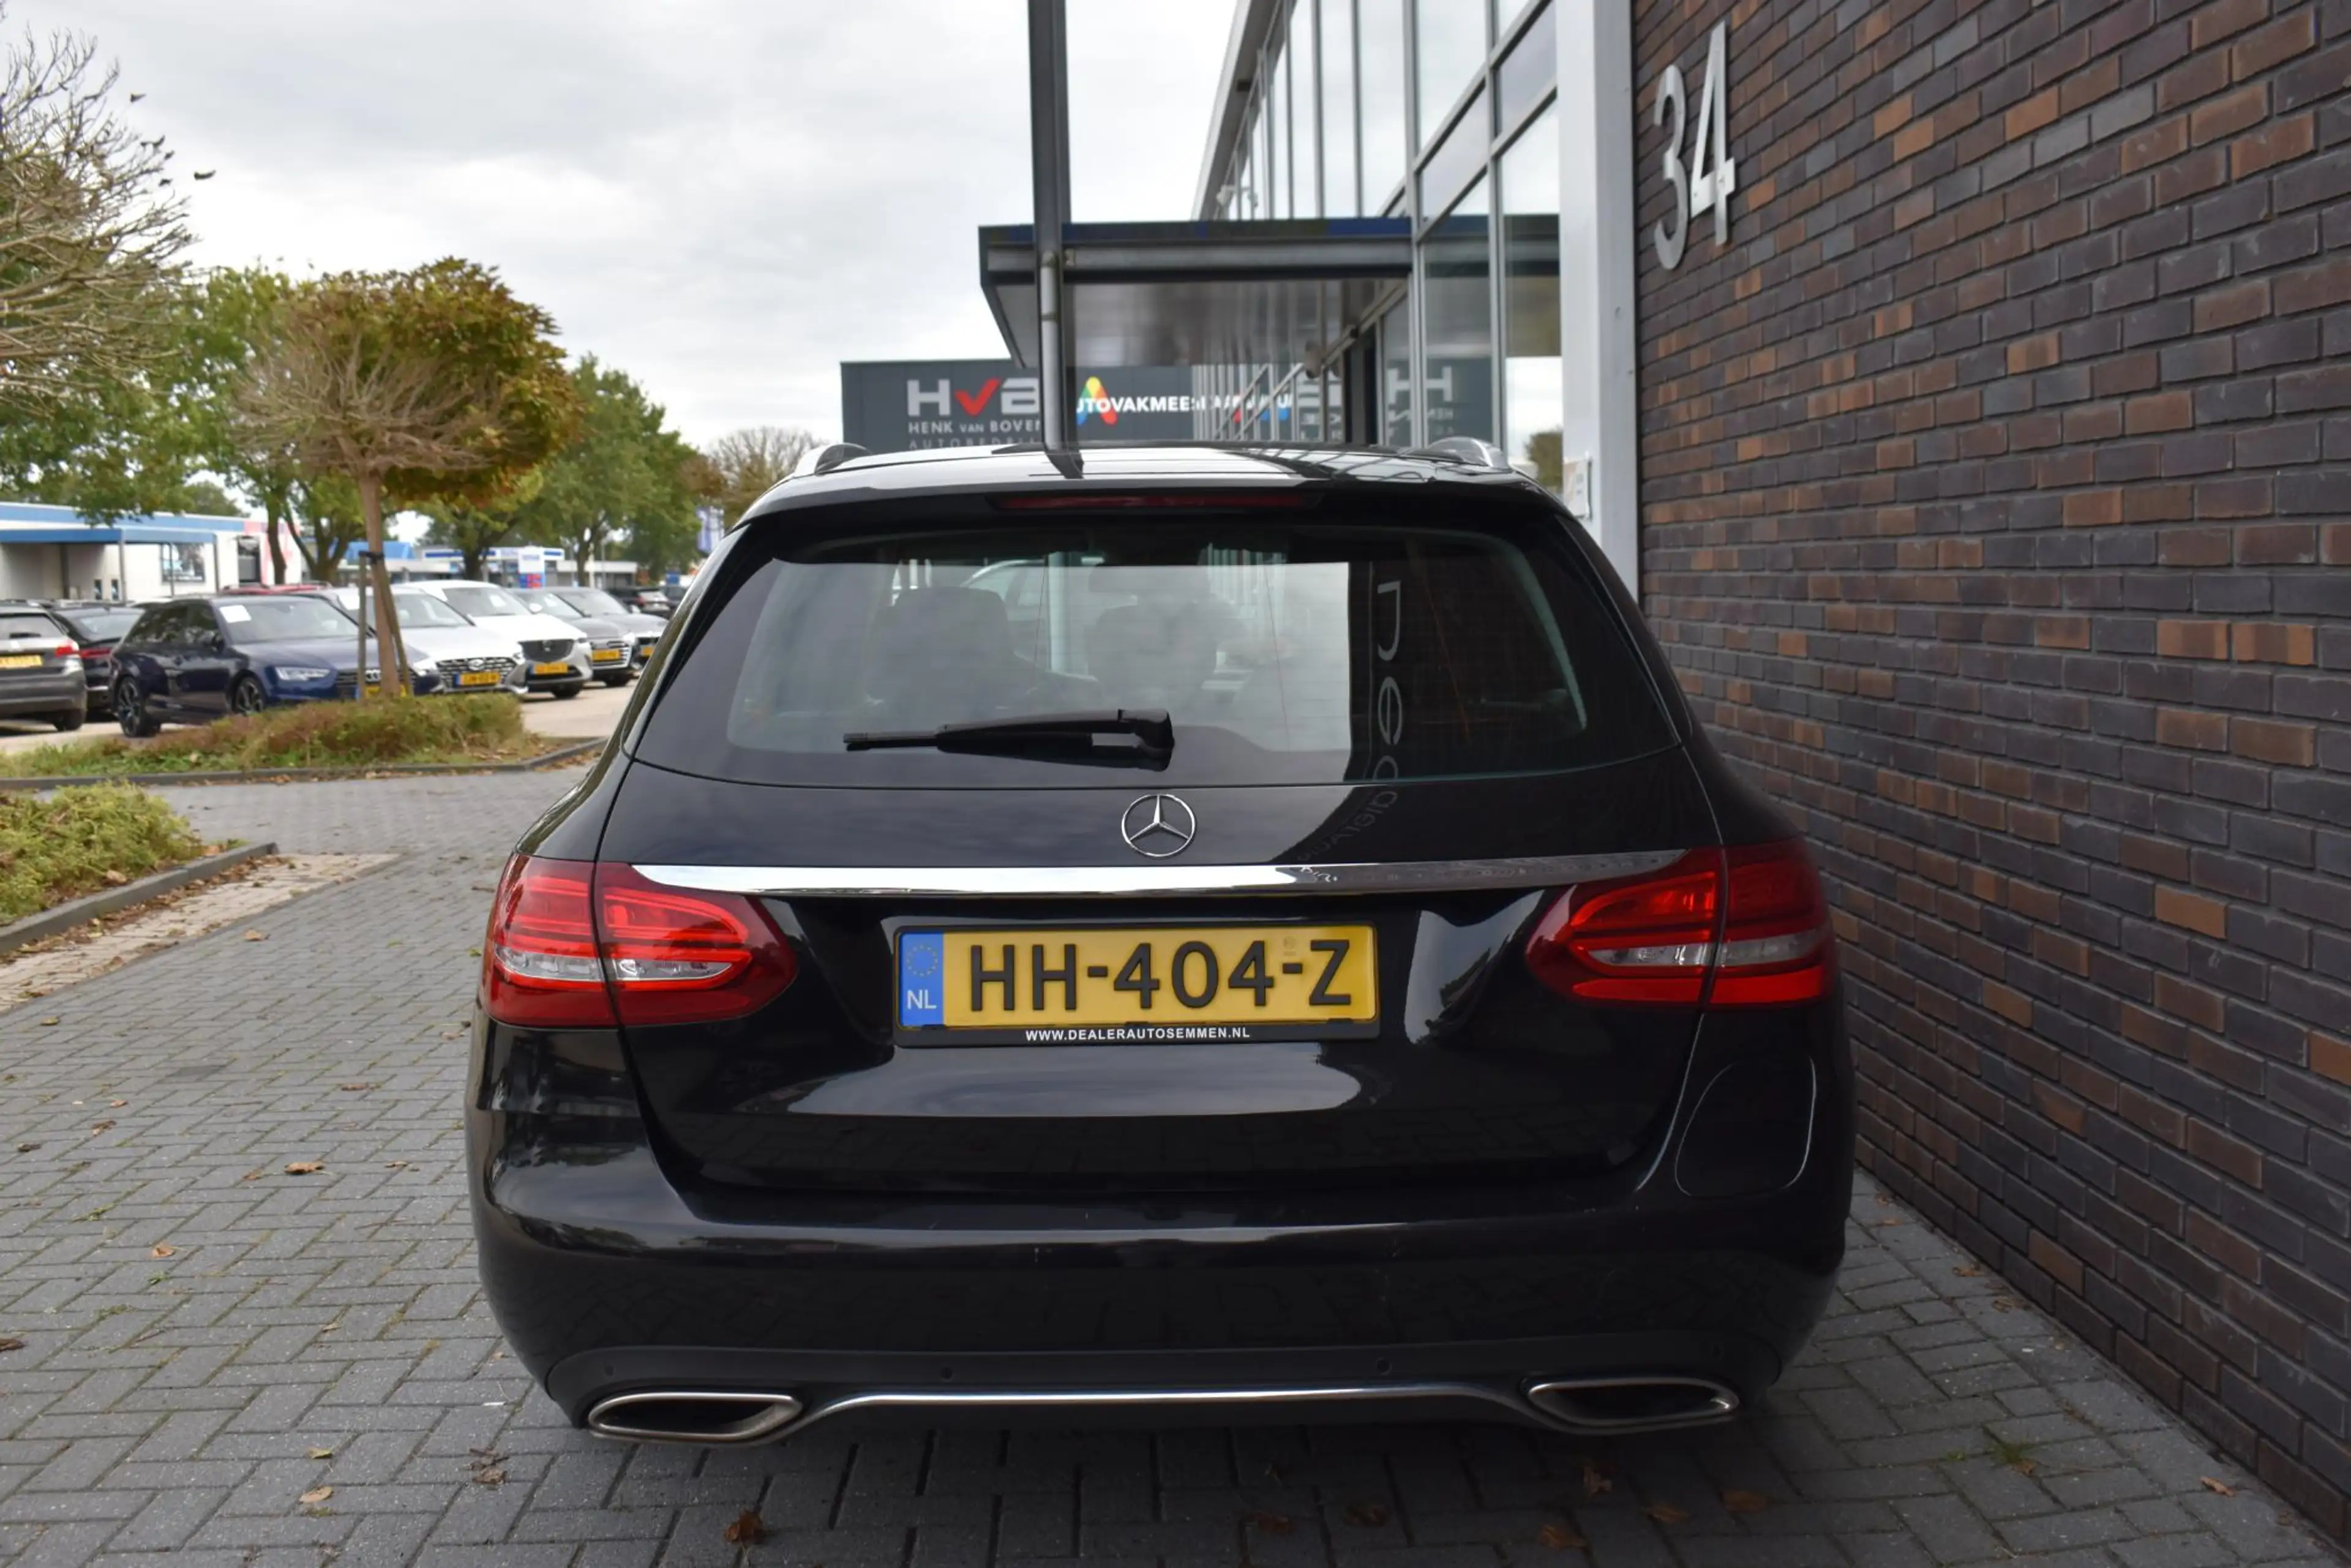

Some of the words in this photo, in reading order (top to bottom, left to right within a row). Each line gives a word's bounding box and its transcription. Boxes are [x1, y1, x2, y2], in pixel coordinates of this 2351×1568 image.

[1653, 20, 1736, 271] 34
[908, 420, 953, 435] HENK
[907, 989, 937, 1010] NL
[969, 939, 1352, 1012] HH-404-Z
[1026, 1027, 1250, 1041] WWW.DEALERAUTOSEMMEN.NL
